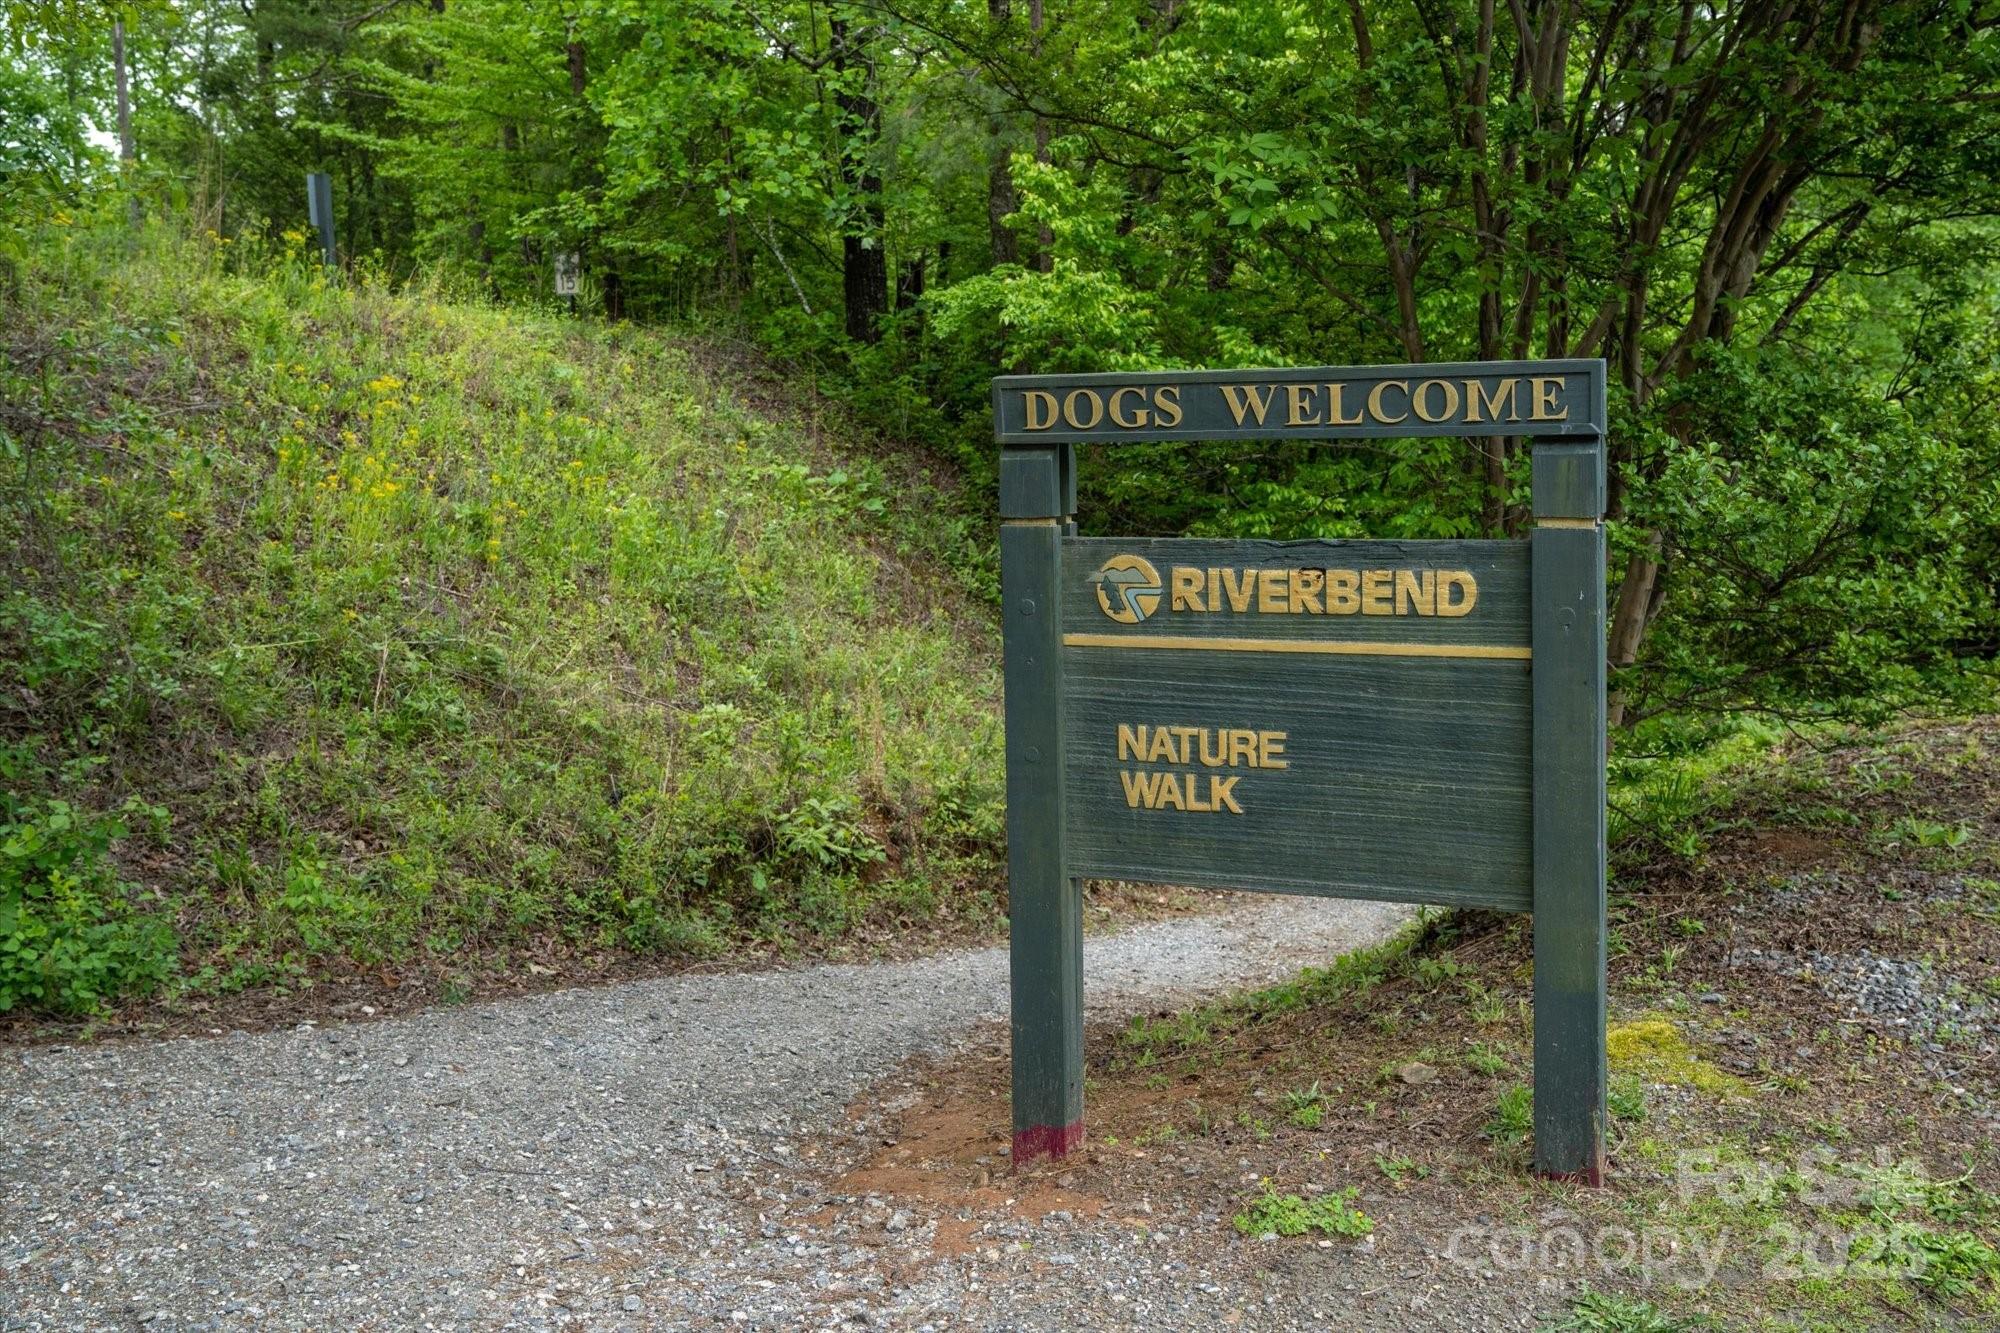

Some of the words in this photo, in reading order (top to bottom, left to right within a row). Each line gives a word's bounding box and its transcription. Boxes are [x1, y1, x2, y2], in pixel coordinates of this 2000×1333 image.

[561, 275, 576, 290] 15
[1022, 388, 1183, 431] DOGS
[1219, 377, 1569, 425] WELCOME
[1171, 567, 1478, 617] RIVERBEND
[1117, 724, 1290, 768] NATURE
[1119, 771, 1243, 814] WALK
